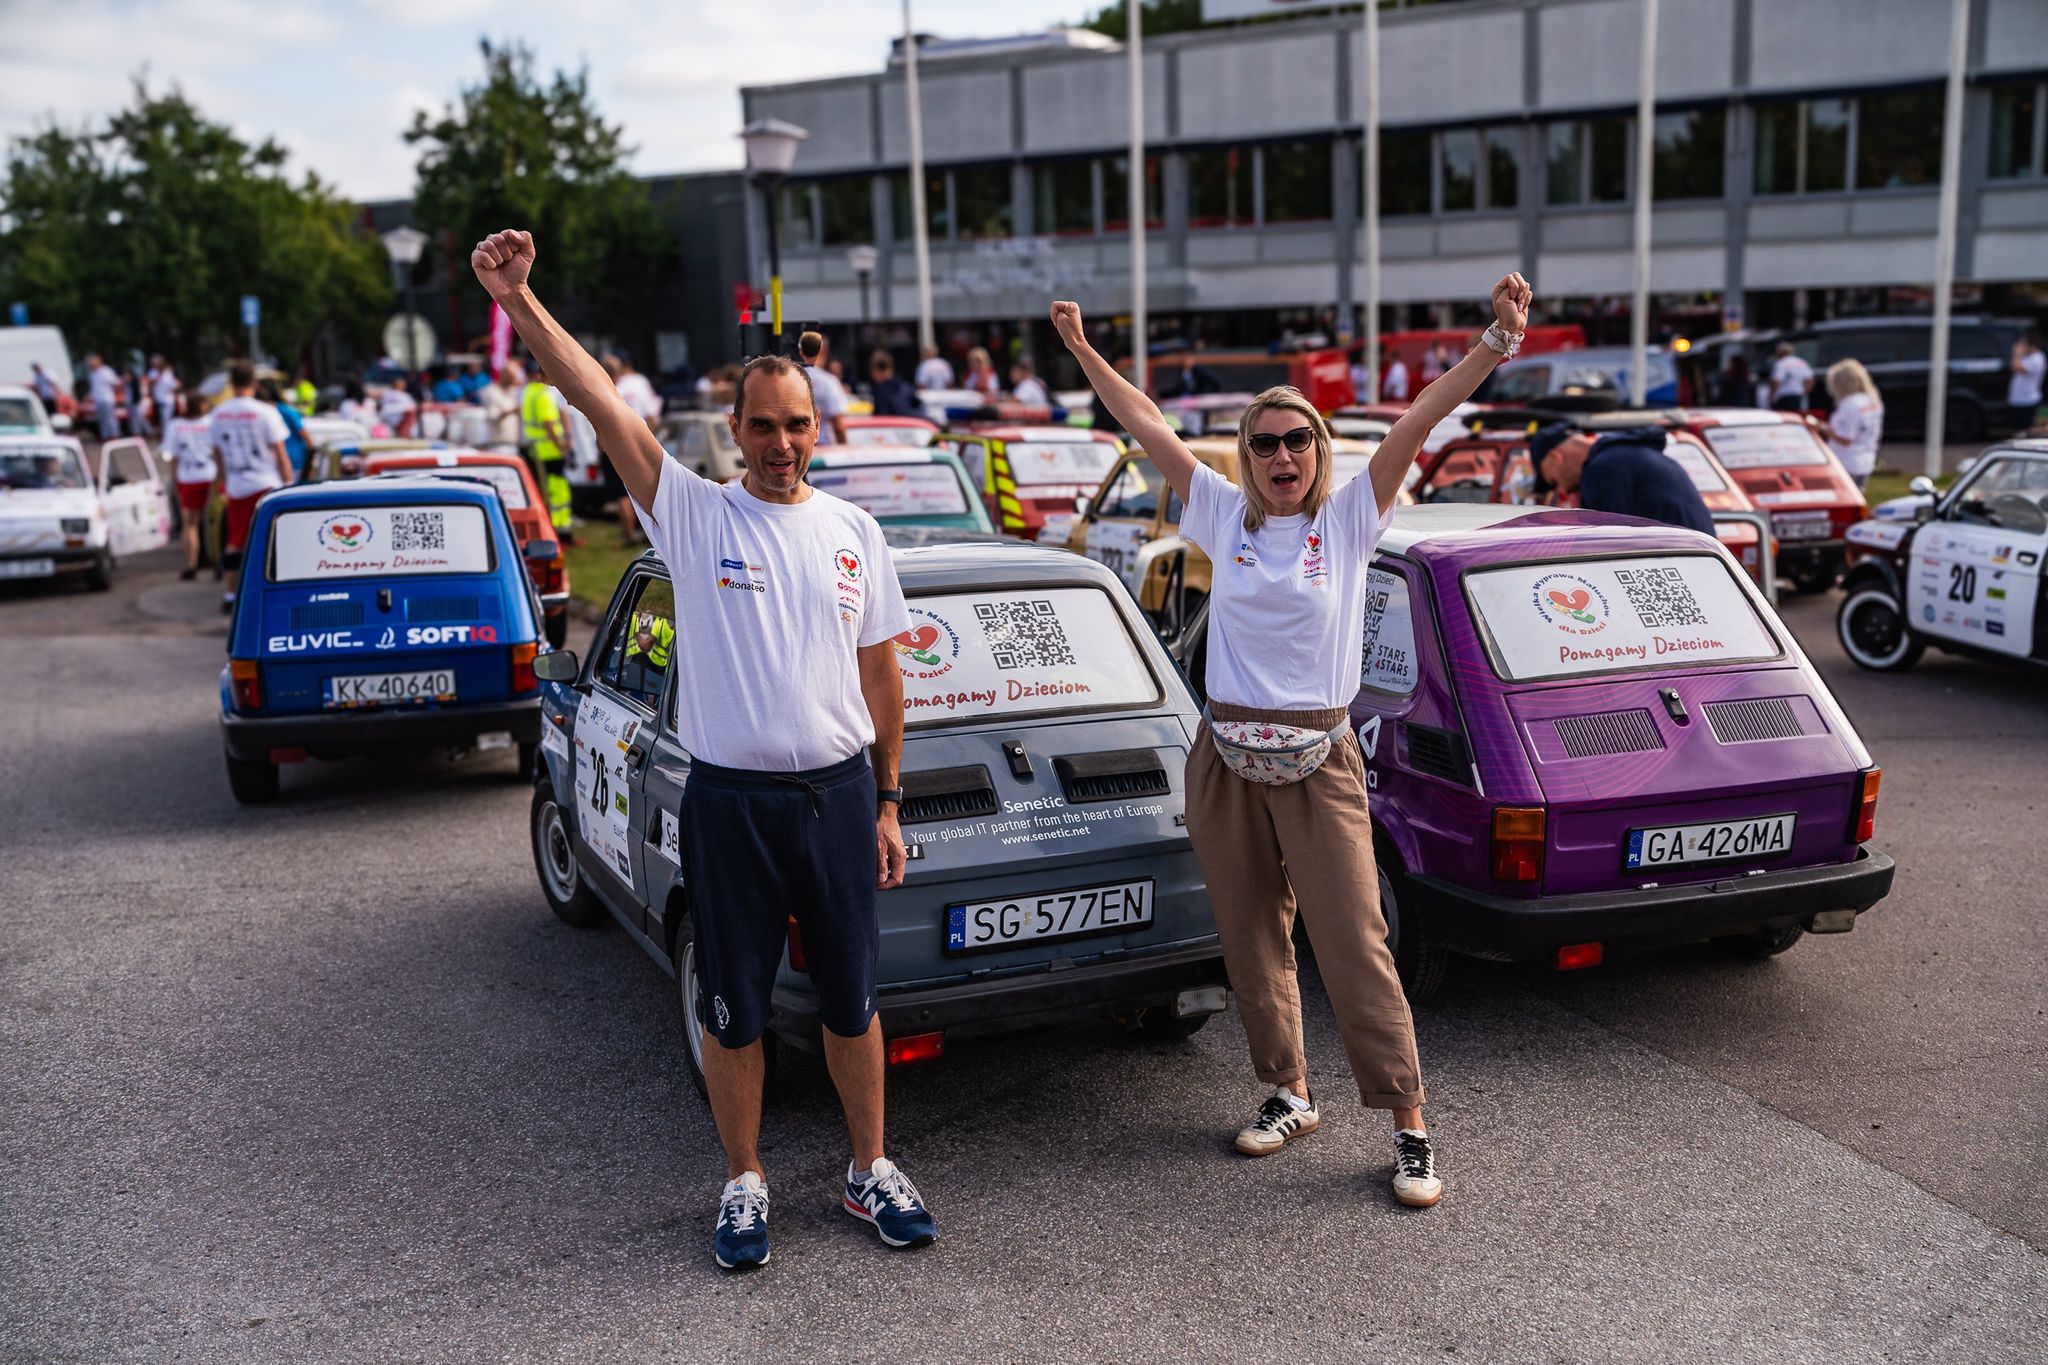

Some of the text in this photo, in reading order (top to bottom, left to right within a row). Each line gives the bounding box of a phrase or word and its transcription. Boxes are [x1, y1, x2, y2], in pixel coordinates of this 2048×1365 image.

[316, 555, 448, 572] Pomagamy Dzieciom
[729, 580, 765, 593] donateo
[1376, 573, 1396, 586] Dzieci
[1948, 563, 1976, 604] 20
[1532, 573, 1610, 623] Wielka Wyprawa Maluchów
[406, 625, 498, 645] SOFTIQ
[926, 611, 960, 659] Maluchów
[1558, 620, 1606, 635] dla Dzieci
[1377, 645, 1406, 662] STARS
[1559, 636, 1725, 663] Pomagamy Dzieciom
[918, 662, 952, 679] Dzieci
[1375, 659, 1409, 677] 4STARS
[337, 673, 449, 700] KK 40640
[903, 679, 1091, 710] omagamy Dzieciom
[1003, 796, 1064, 814] Senetic
[910, 803, 1164, 844] Your global IT partner from the heart of Europe
[1001, 826, 1091, 845] www.senetic.net
[1647, 820, 1785, 863] GA 426MA
[1628, 853, 1639, 862] PL
[974, 885, 1144, 942] SG 577EN
[950, 932, 964, 944] PL
